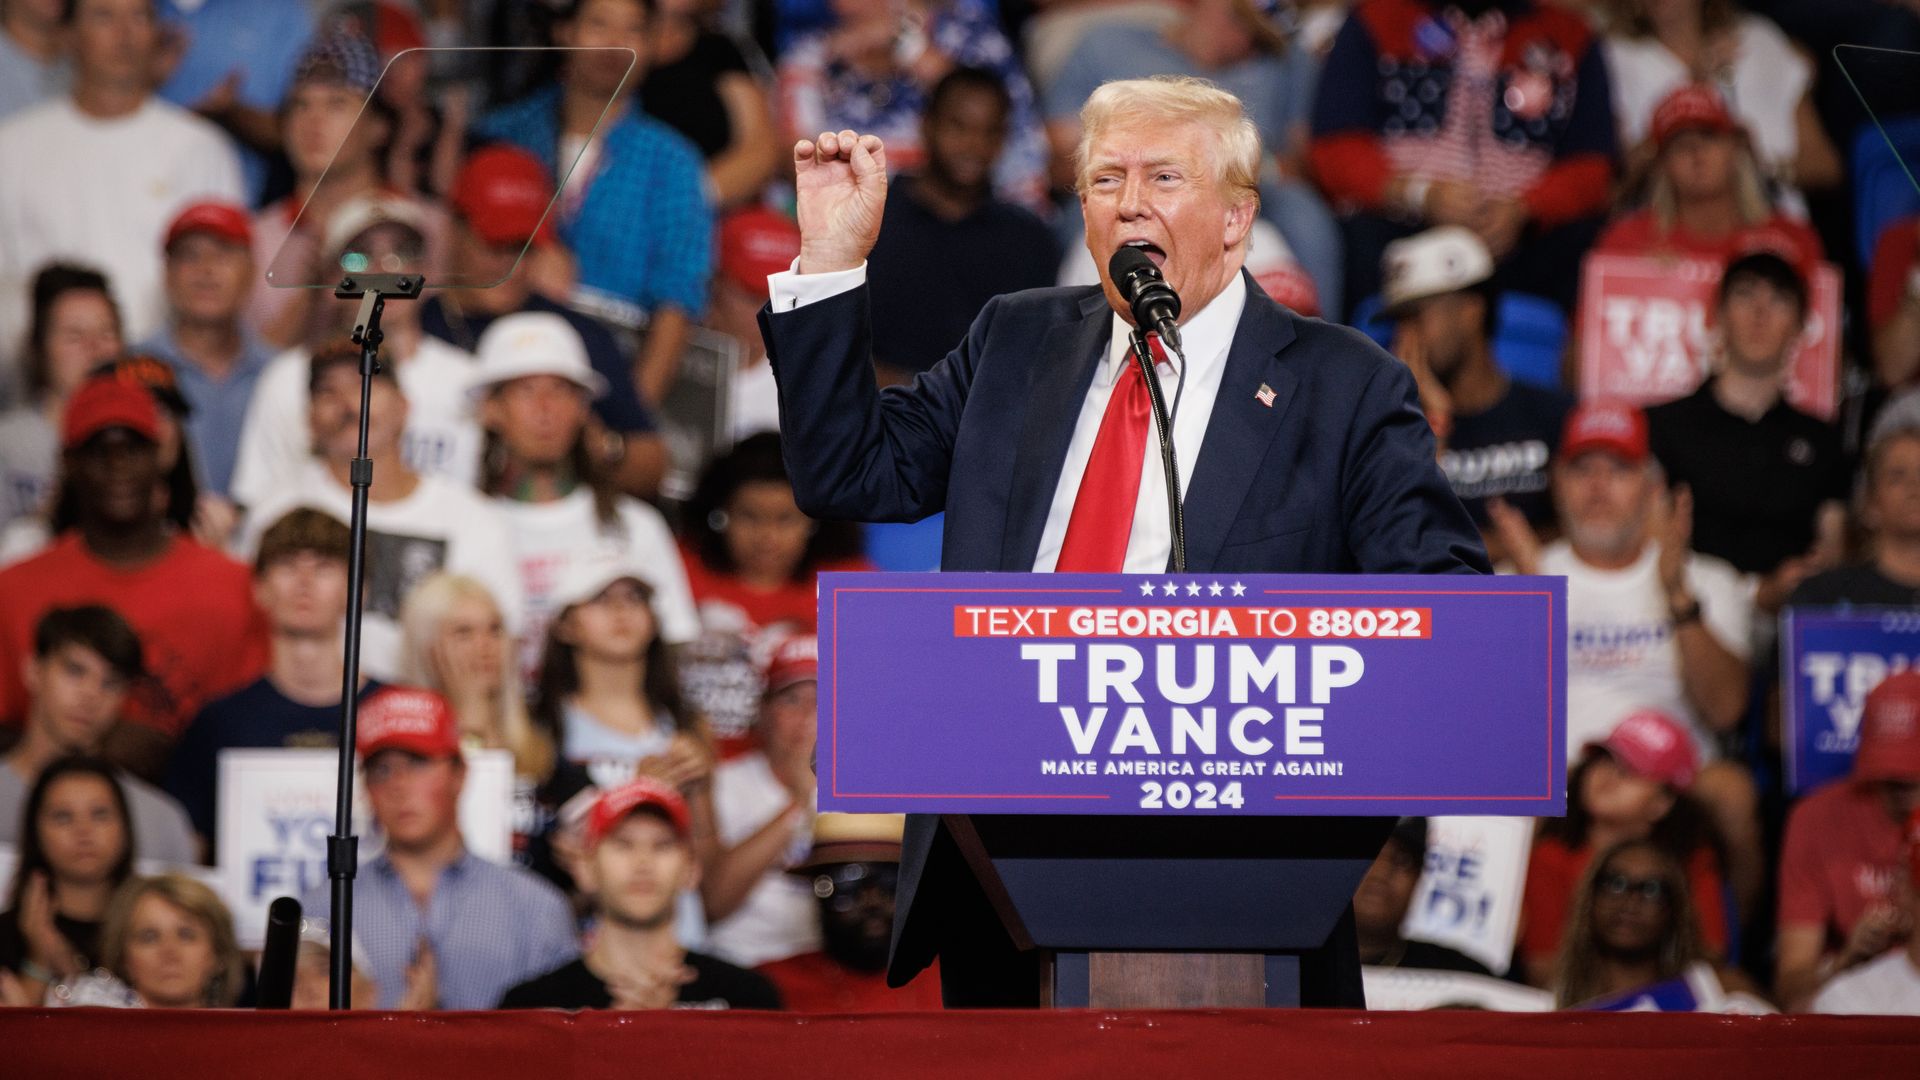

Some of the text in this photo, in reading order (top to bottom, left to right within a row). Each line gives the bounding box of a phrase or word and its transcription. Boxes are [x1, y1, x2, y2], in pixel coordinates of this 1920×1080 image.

[965, 607, 1421, 637] TEXT GEORGIA TO 88022
[1020, 643, 1365, 705] TRUMP
[1058, 705, 1325, 756] VANCE
[1040, 759, 1344, 776] MAKE AMERICA GREAT AGAIN!
[1139, 780, 1245, 810] 2024
